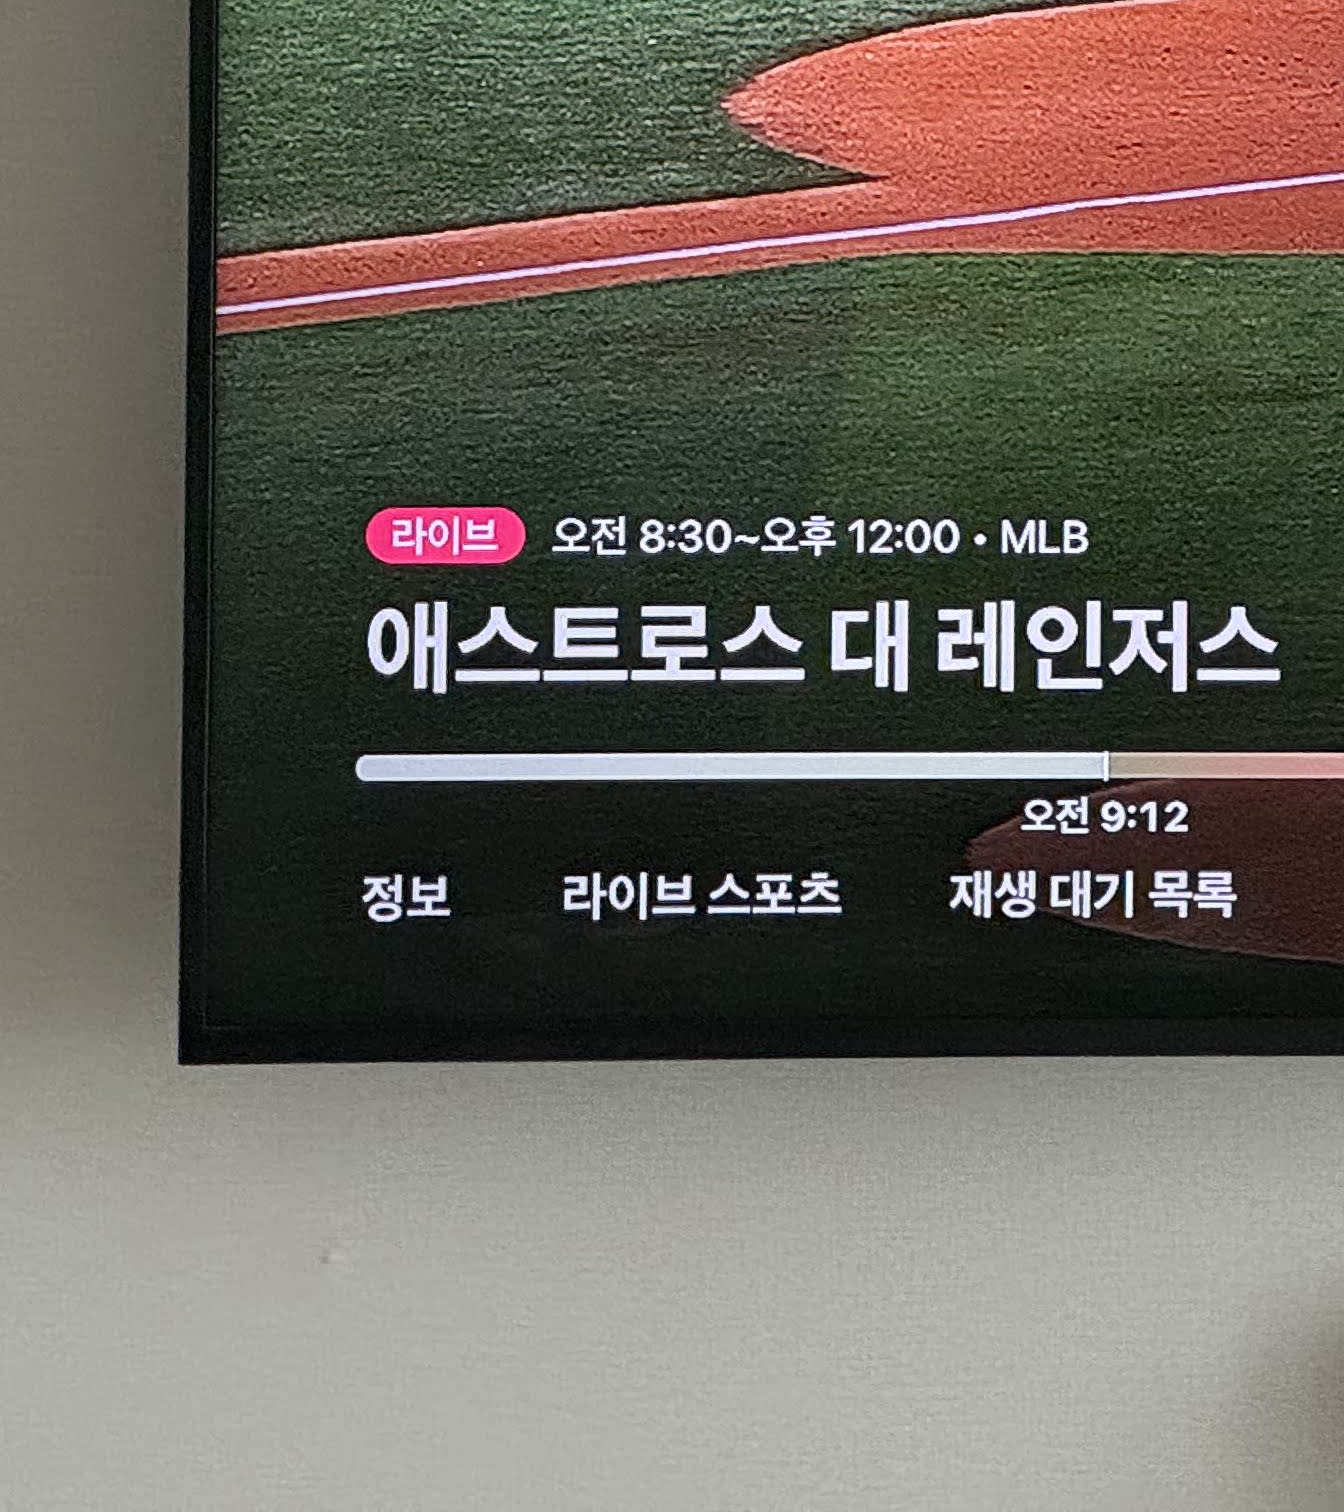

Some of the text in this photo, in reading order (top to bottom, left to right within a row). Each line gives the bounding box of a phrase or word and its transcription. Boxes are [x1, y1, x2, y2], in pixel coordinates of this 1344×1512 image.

[391, 516, 499, 554] 라이브
[551, 515, 1089, 557] 오전 8:30~오후 12:00 MLB
[367, 599, 1281, 695] 애스트로스 대 레인저스
[1020, 797, 1190, 835] 오전 9:12
[361, 873, 451, 922] 정보
[563, 871, 843, 921] 라이브 스포츠
[949, 869, 1238, 919] 재생 대기 목록
